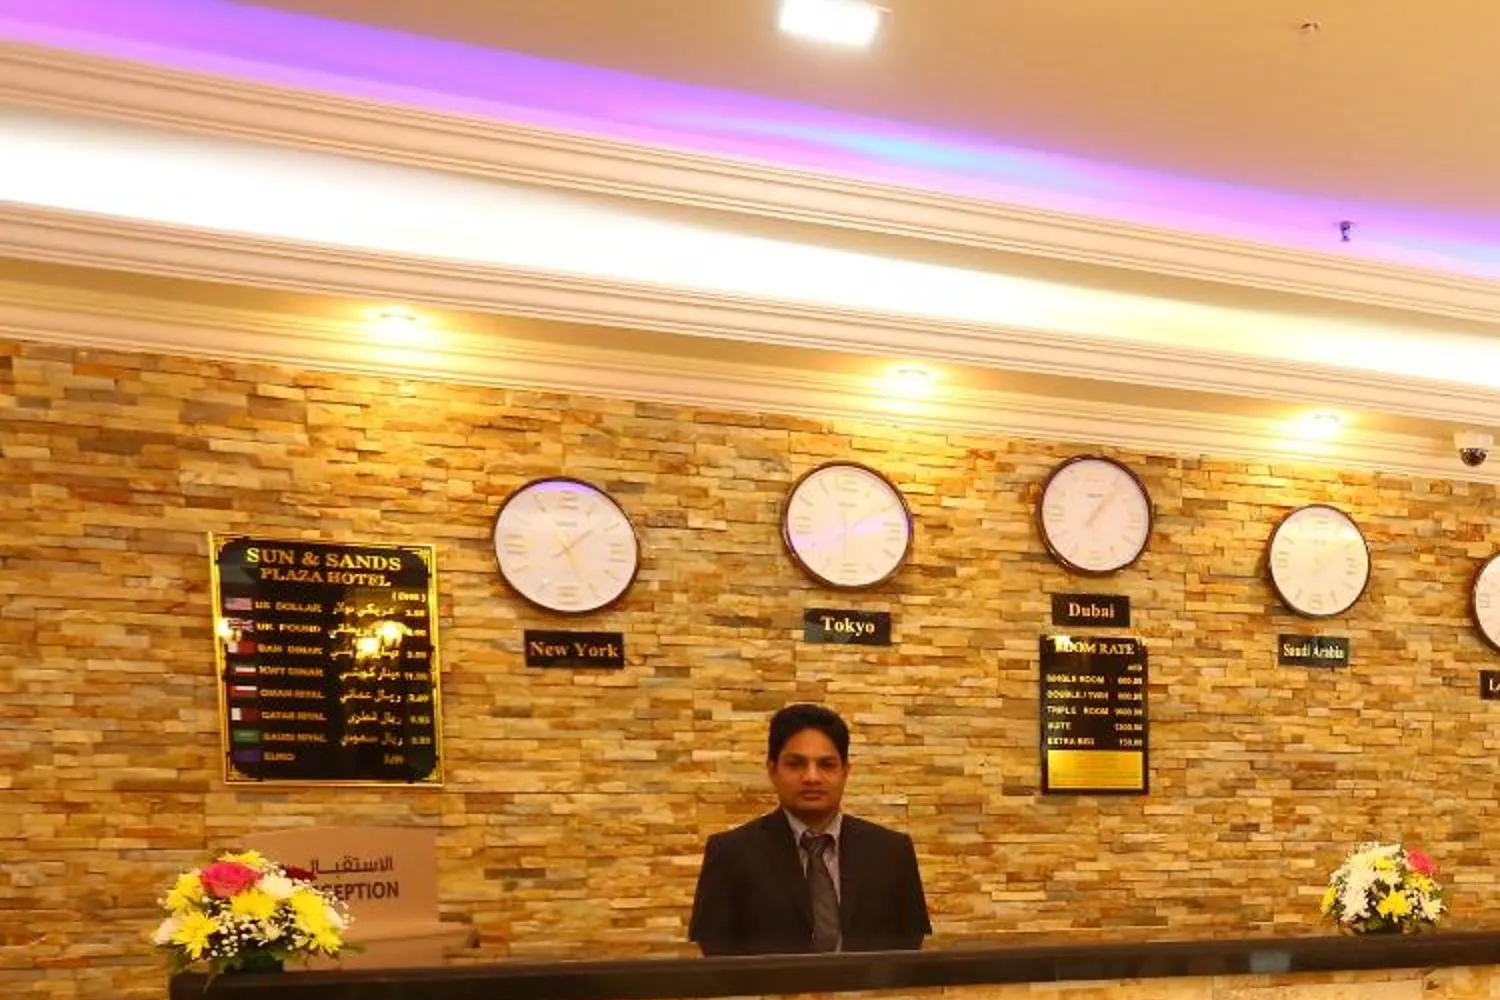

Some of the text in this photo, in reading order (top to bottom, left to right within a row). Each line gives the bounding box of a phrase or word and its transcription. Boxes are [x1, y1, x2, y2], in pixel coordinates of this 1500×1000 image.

[246, 547, 401, 571] SUN & SANDS
[260, 567, 391, 588] PLAZA HOTEL
[1069, 603, 1115, 619] Dubai
[821, 615, 875, 637] Tokyo
[529, 640, 620, 658] New York
[1099, 643, 1136, 655] RATE
[1283, 643, 1345, 659] Saudi Arabia
